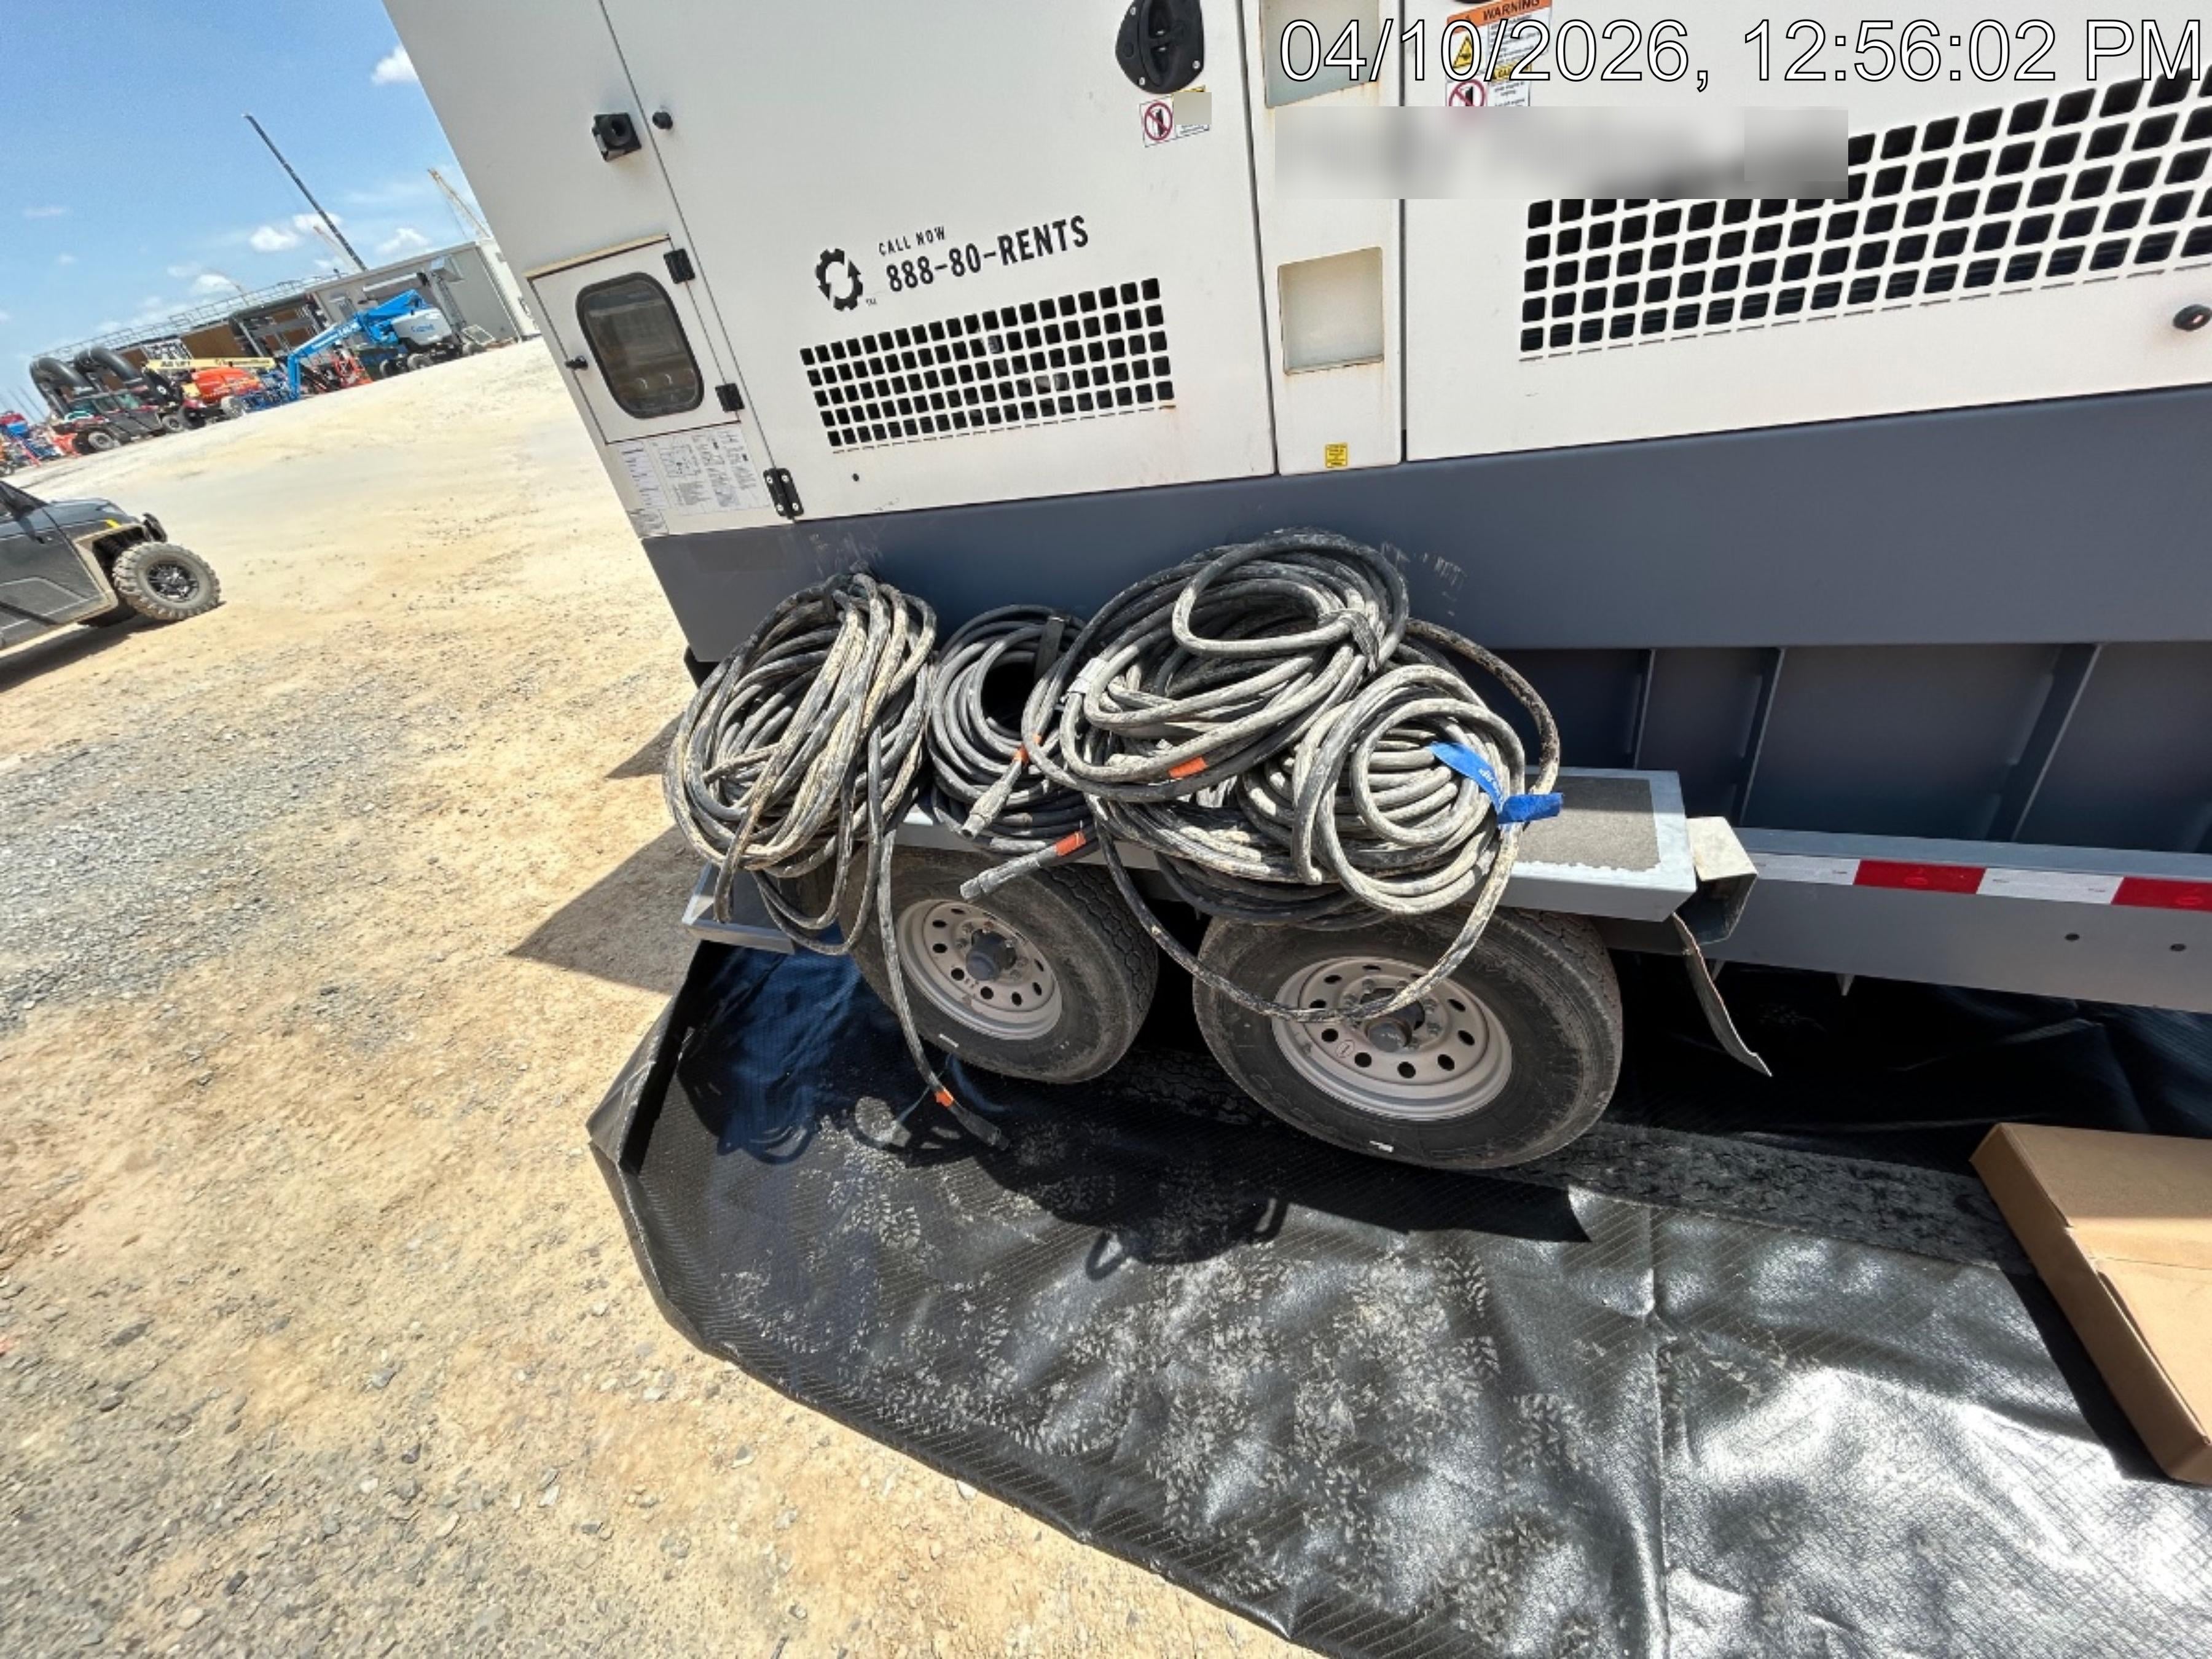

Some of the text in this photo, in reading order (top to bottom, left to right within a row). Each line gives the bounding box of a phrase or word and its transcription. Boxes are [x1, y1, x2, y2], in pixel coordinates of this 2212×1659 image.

[1483, 0, 1539, 20] WARNING
[879, 226, 945, 256] CALL NOW
[887, 215, 1088, 292] 888-80-RENTS
